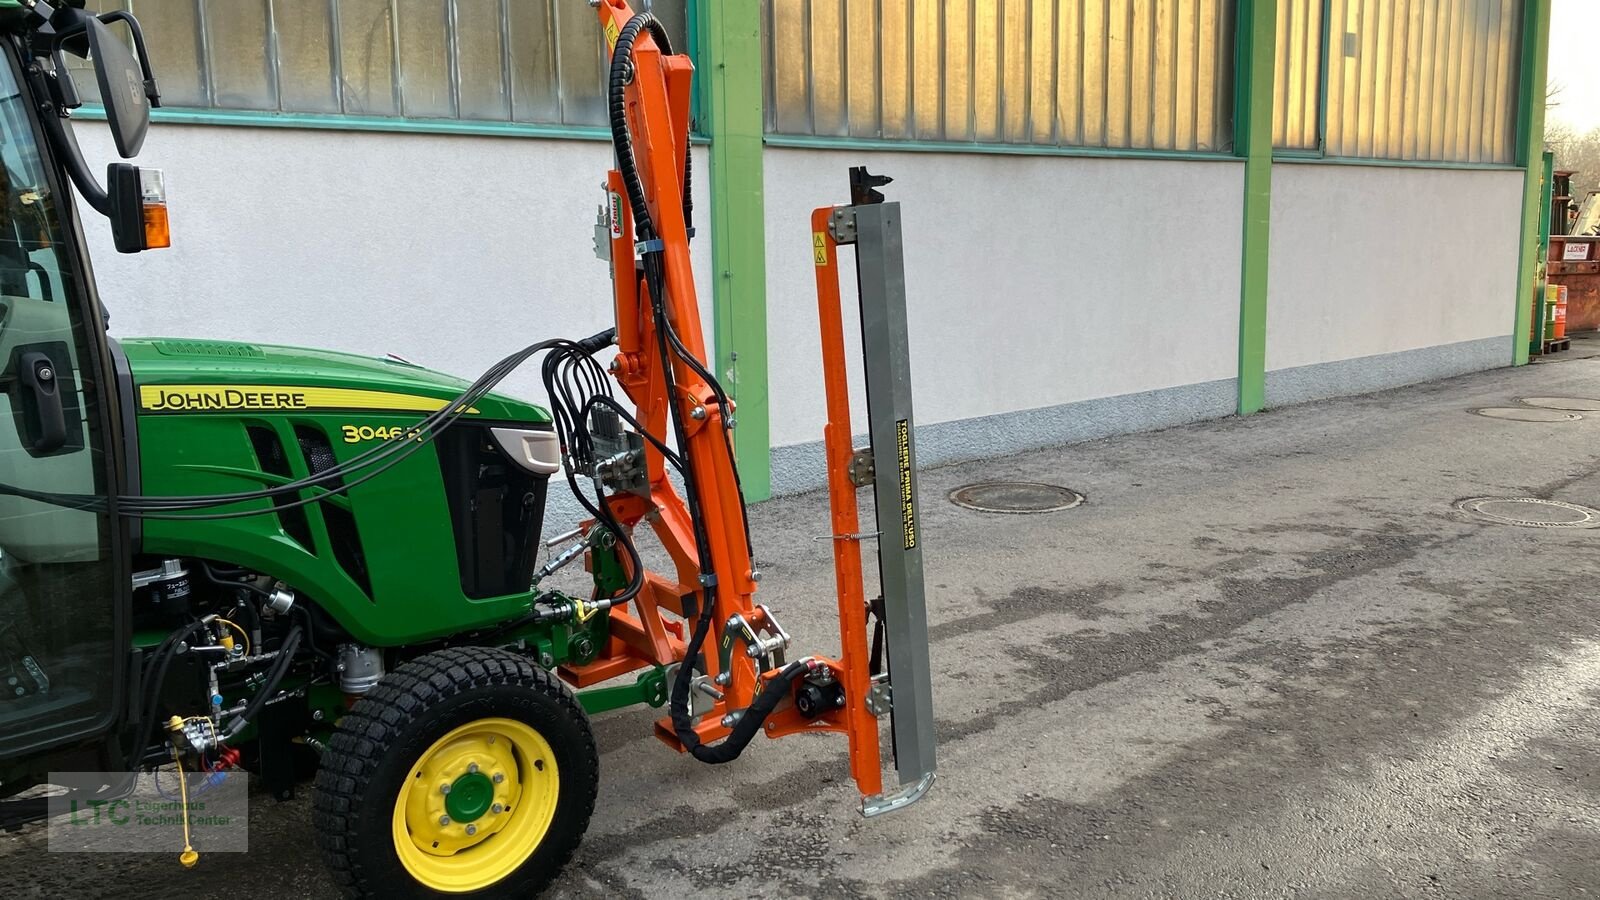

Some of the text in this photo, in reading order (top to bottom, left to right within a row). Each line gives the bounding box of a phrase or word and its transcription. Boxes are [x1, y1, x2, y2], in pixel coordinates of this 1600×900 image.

[151, 389, 307, 409] JOHN DEERE
[901, 420, 909, 468] TOGLIERE
[906, 502, 914, 547] DELL'USO
